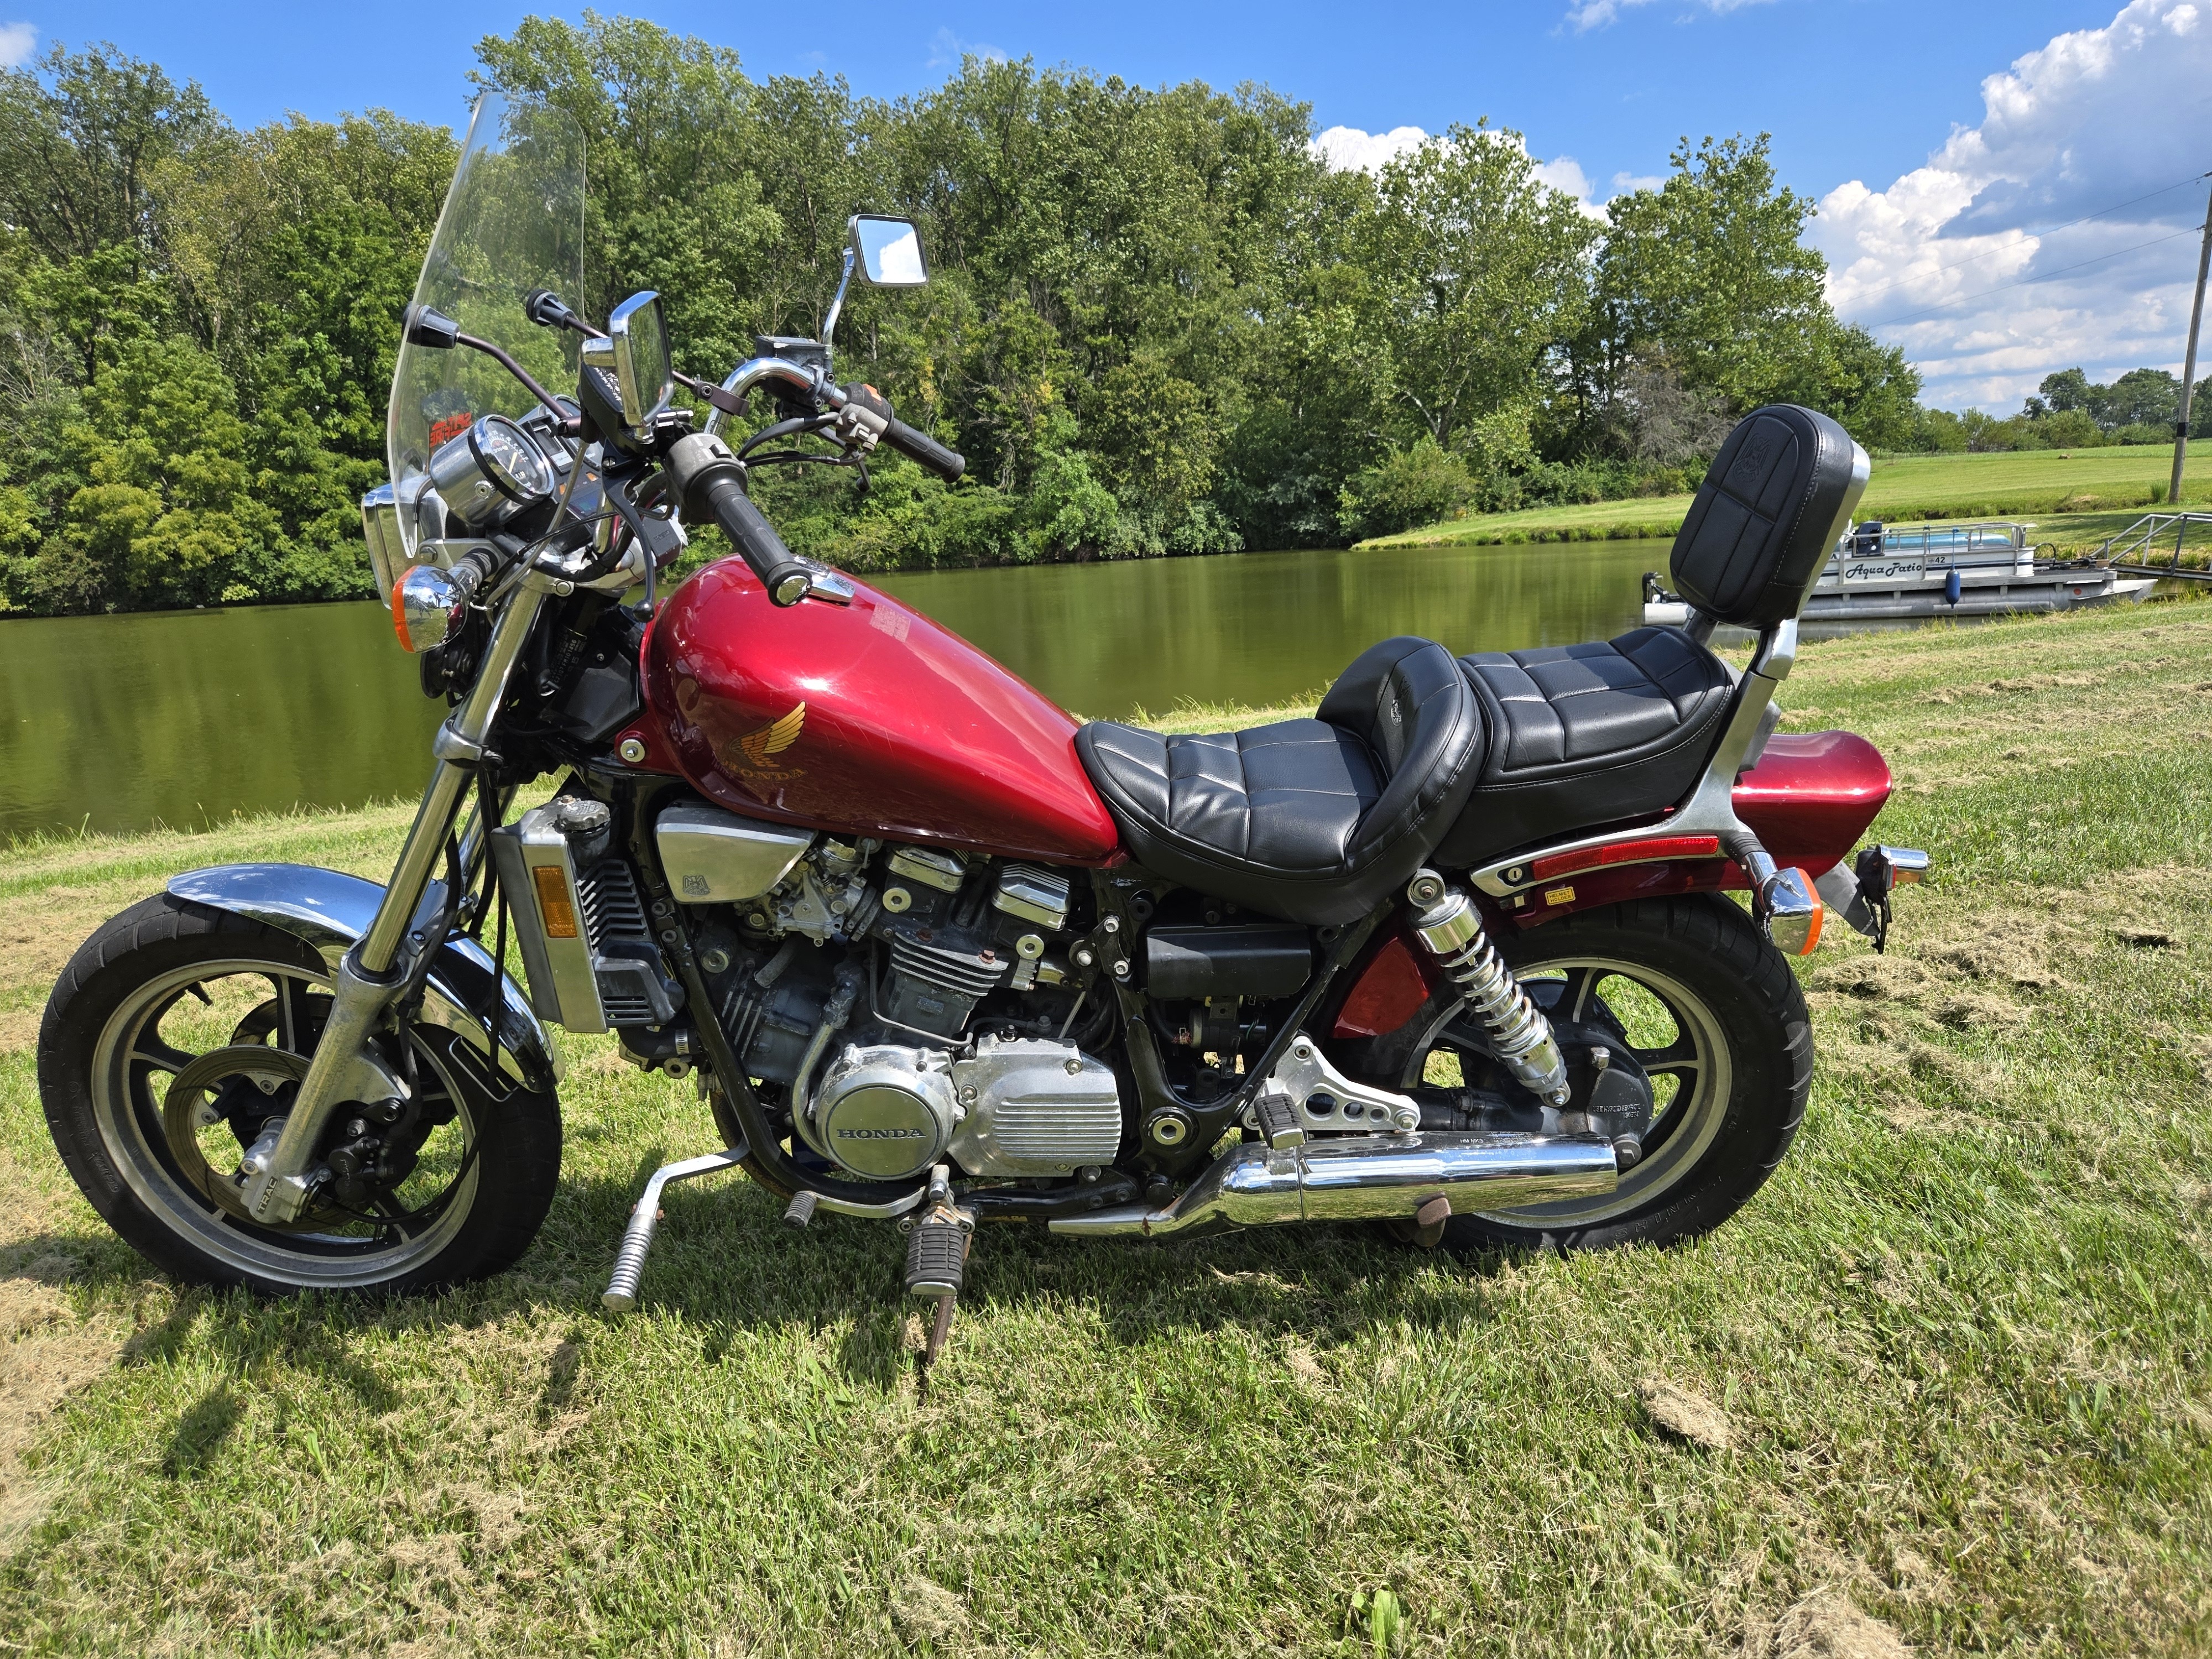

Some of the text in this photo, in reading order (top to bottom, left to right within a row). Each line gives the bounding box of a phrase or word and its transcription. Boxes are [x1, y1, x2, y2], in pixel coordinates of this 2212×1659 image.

[1845, 562, 1922, 580] Aqua Patio
[721, 760, 808, 781] HONDA
[1549, 890, 1570, 899] HELMET
[837, 1128, 927, 1139] HONDA
[258, 1178, 278, 1212] TRAC
